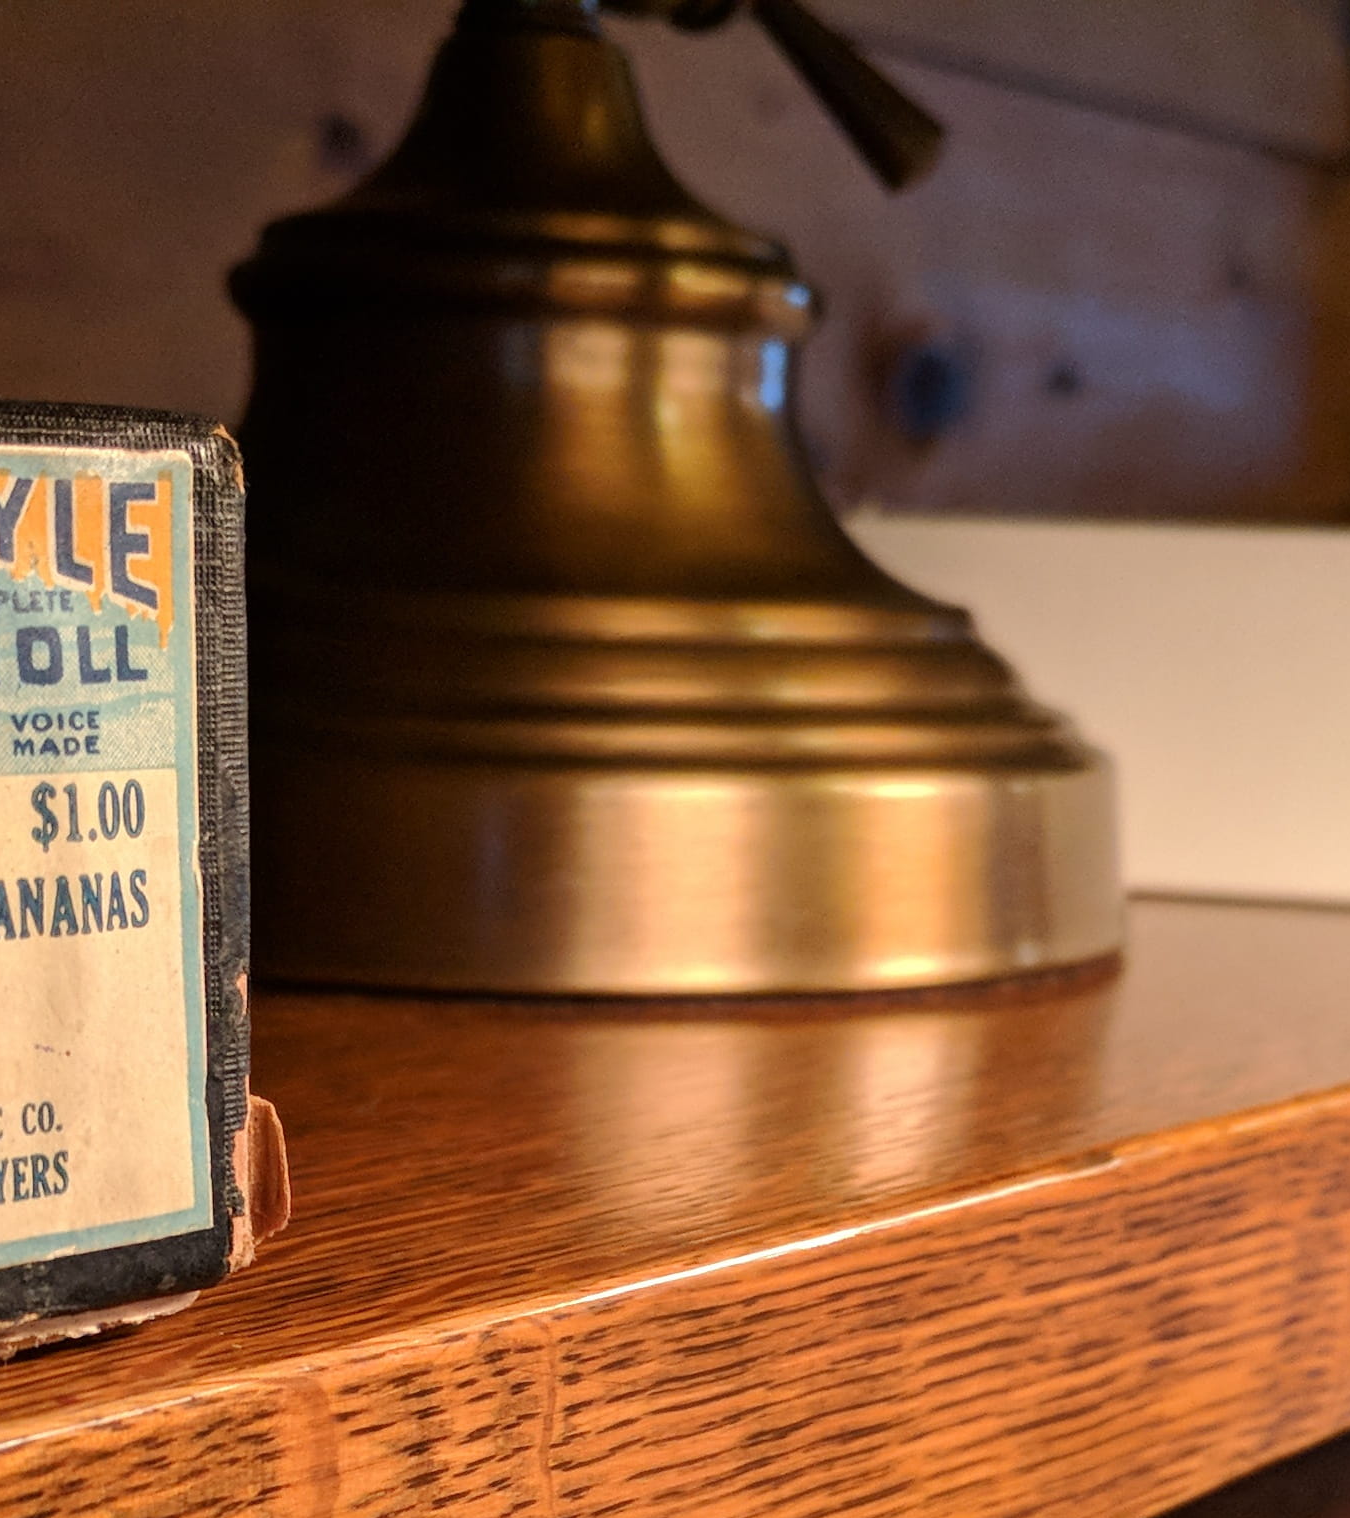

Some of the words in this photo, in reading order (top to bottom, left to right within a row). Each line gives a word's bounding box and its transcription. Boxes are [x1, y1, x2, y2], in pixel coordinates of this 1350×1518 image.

[10, 711, 100, 732] VOICE
[13, 736, 100, 757] MADE
[31, 778, 146, 852] $1.00
[21, 1101, 64, 1133] CO.
